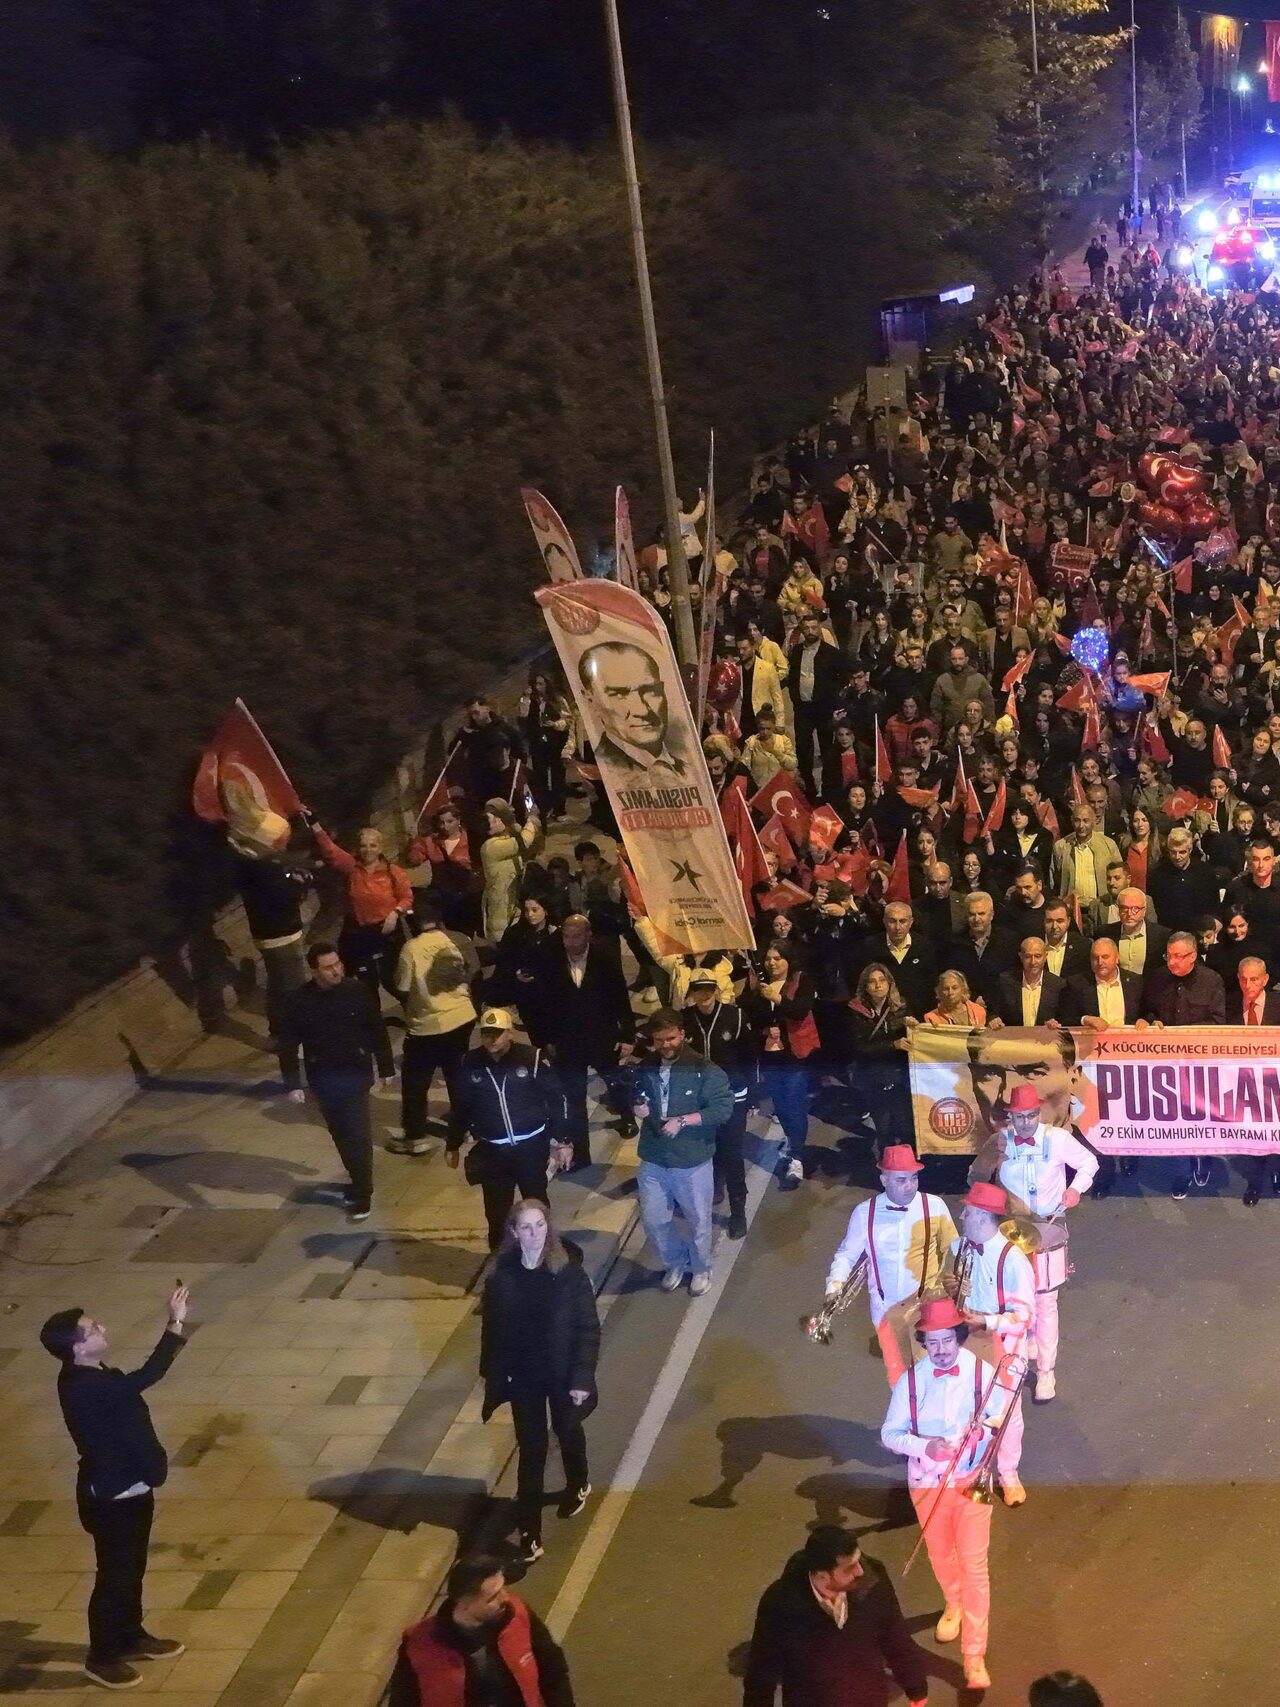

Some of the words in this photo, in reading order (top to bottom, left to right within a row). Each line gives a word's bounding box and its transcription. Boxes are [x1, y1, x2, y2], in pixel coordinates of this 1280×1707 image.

[1113, 1042, 1208, 1055] KÜÇÜKÇEKMECE
[1212, 1043, 1277, 1056] BELEDİYESİ
[1100, 1126, 1114, 1139] 29
[1118, 1124, 1144, 1139] EKİM
[1148, 1124, 1217, 1140] CUMHURİYET
[1220, 1127, 1267, 1141] BAYRAMI
